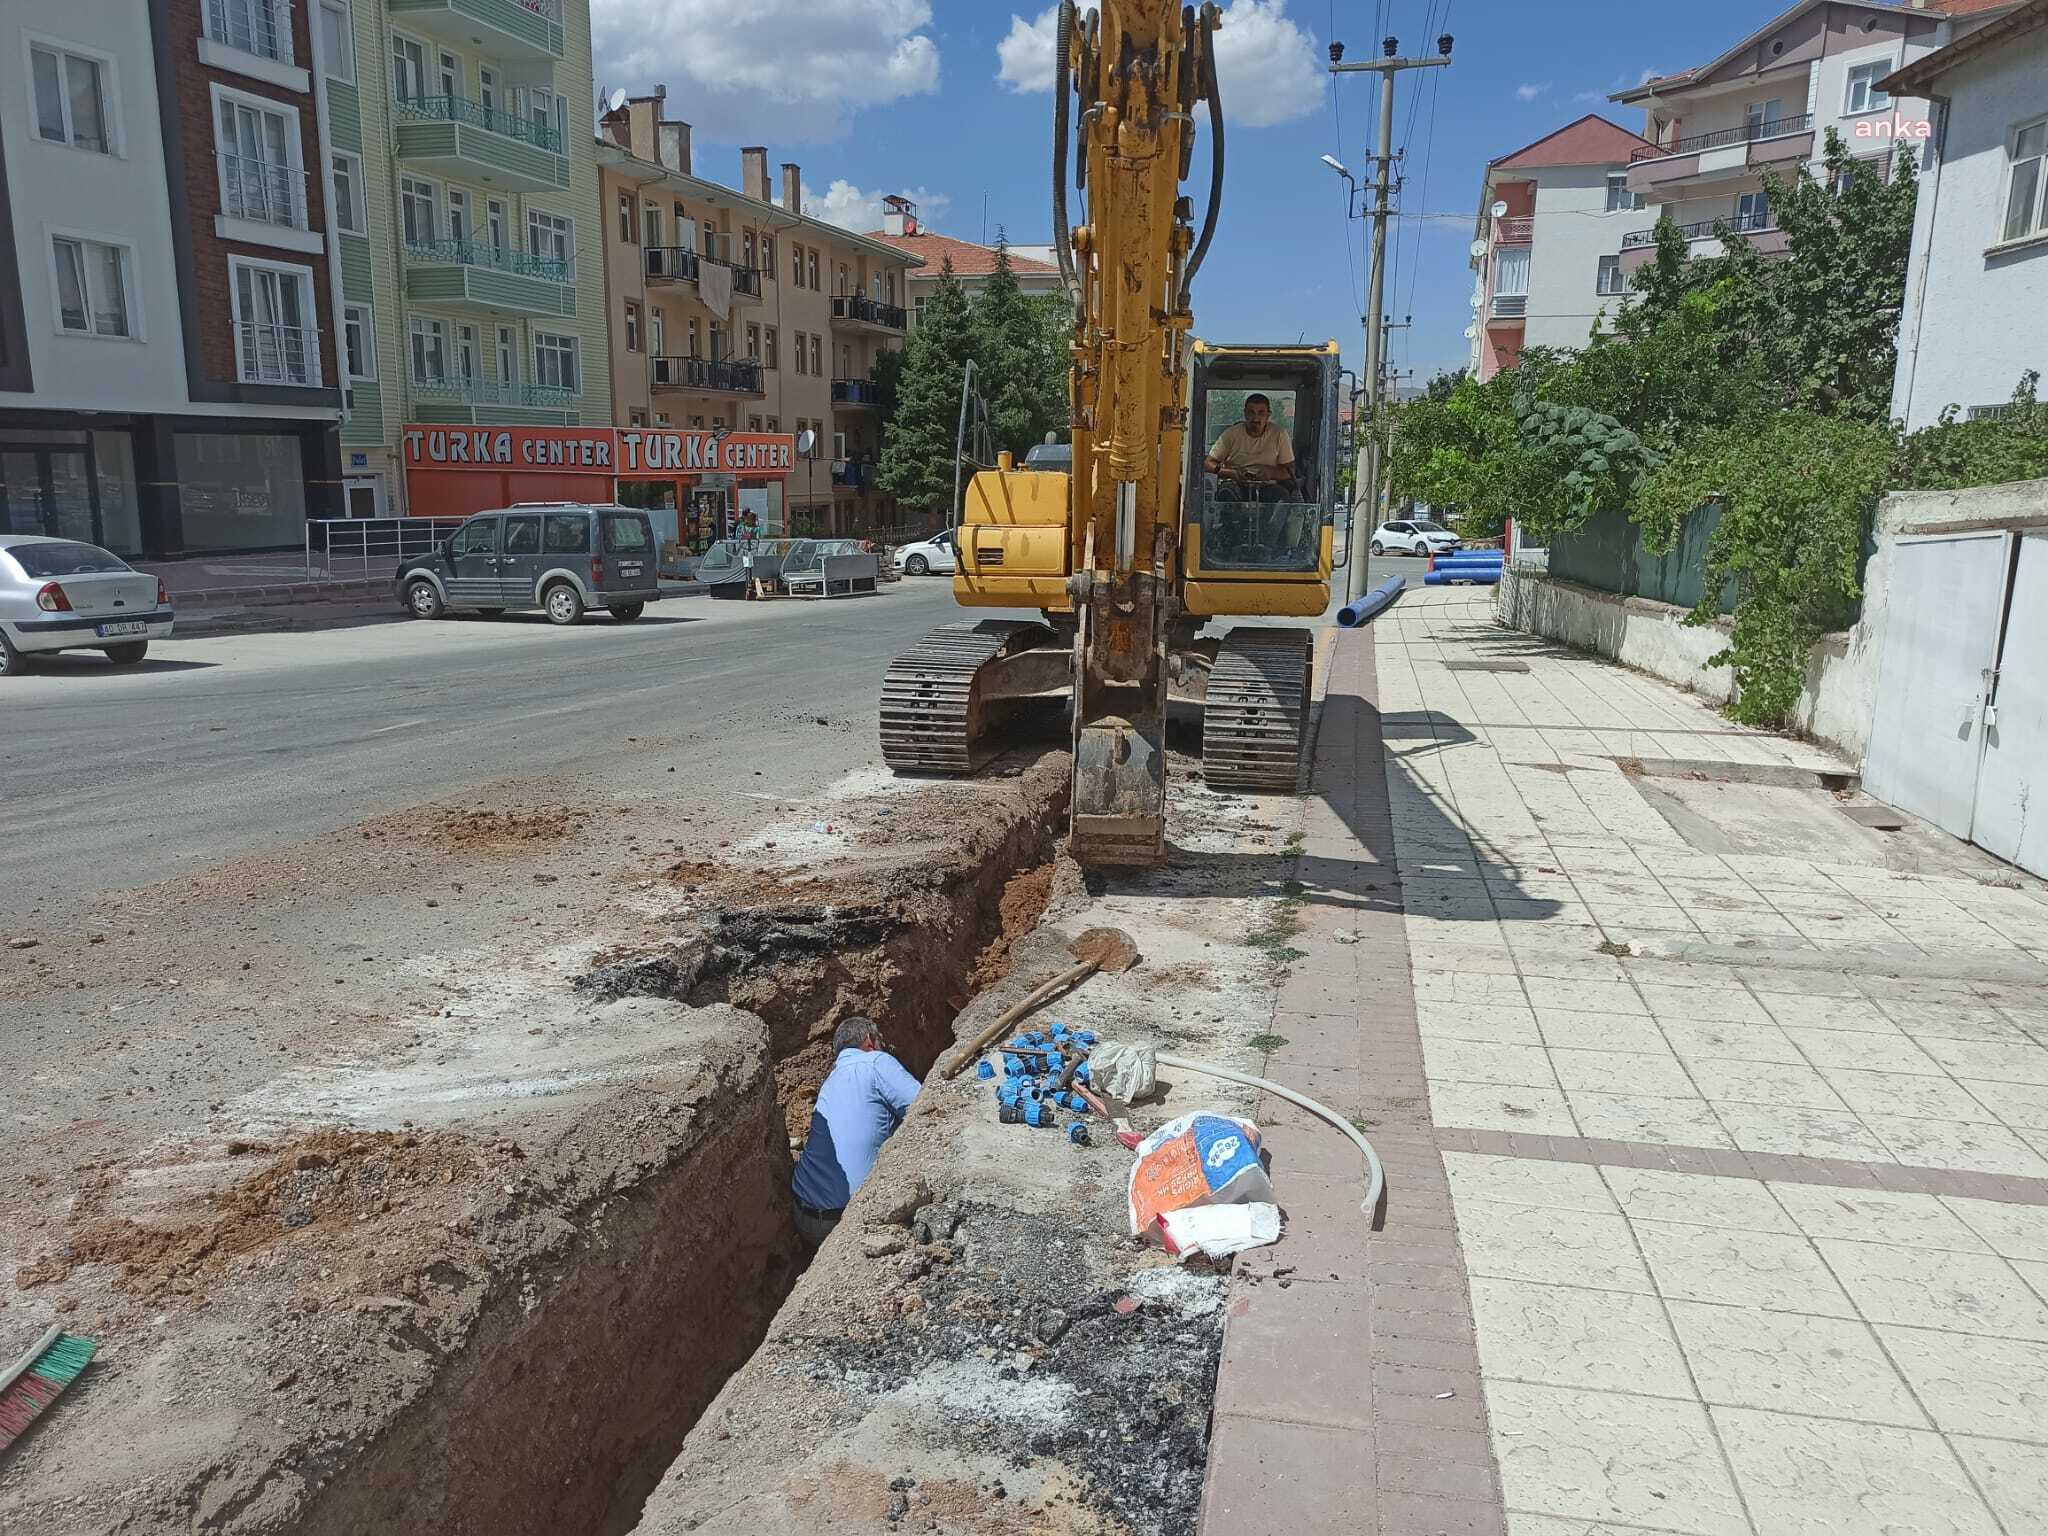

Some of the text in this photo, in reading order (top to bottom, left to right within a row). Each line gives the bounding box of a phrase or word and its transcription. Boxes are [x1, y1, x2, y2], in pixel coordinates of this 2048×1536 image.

[405, 430, 611, 466] TURKA CENTER
[624, 433, 790, 469] TURKA CENTER
